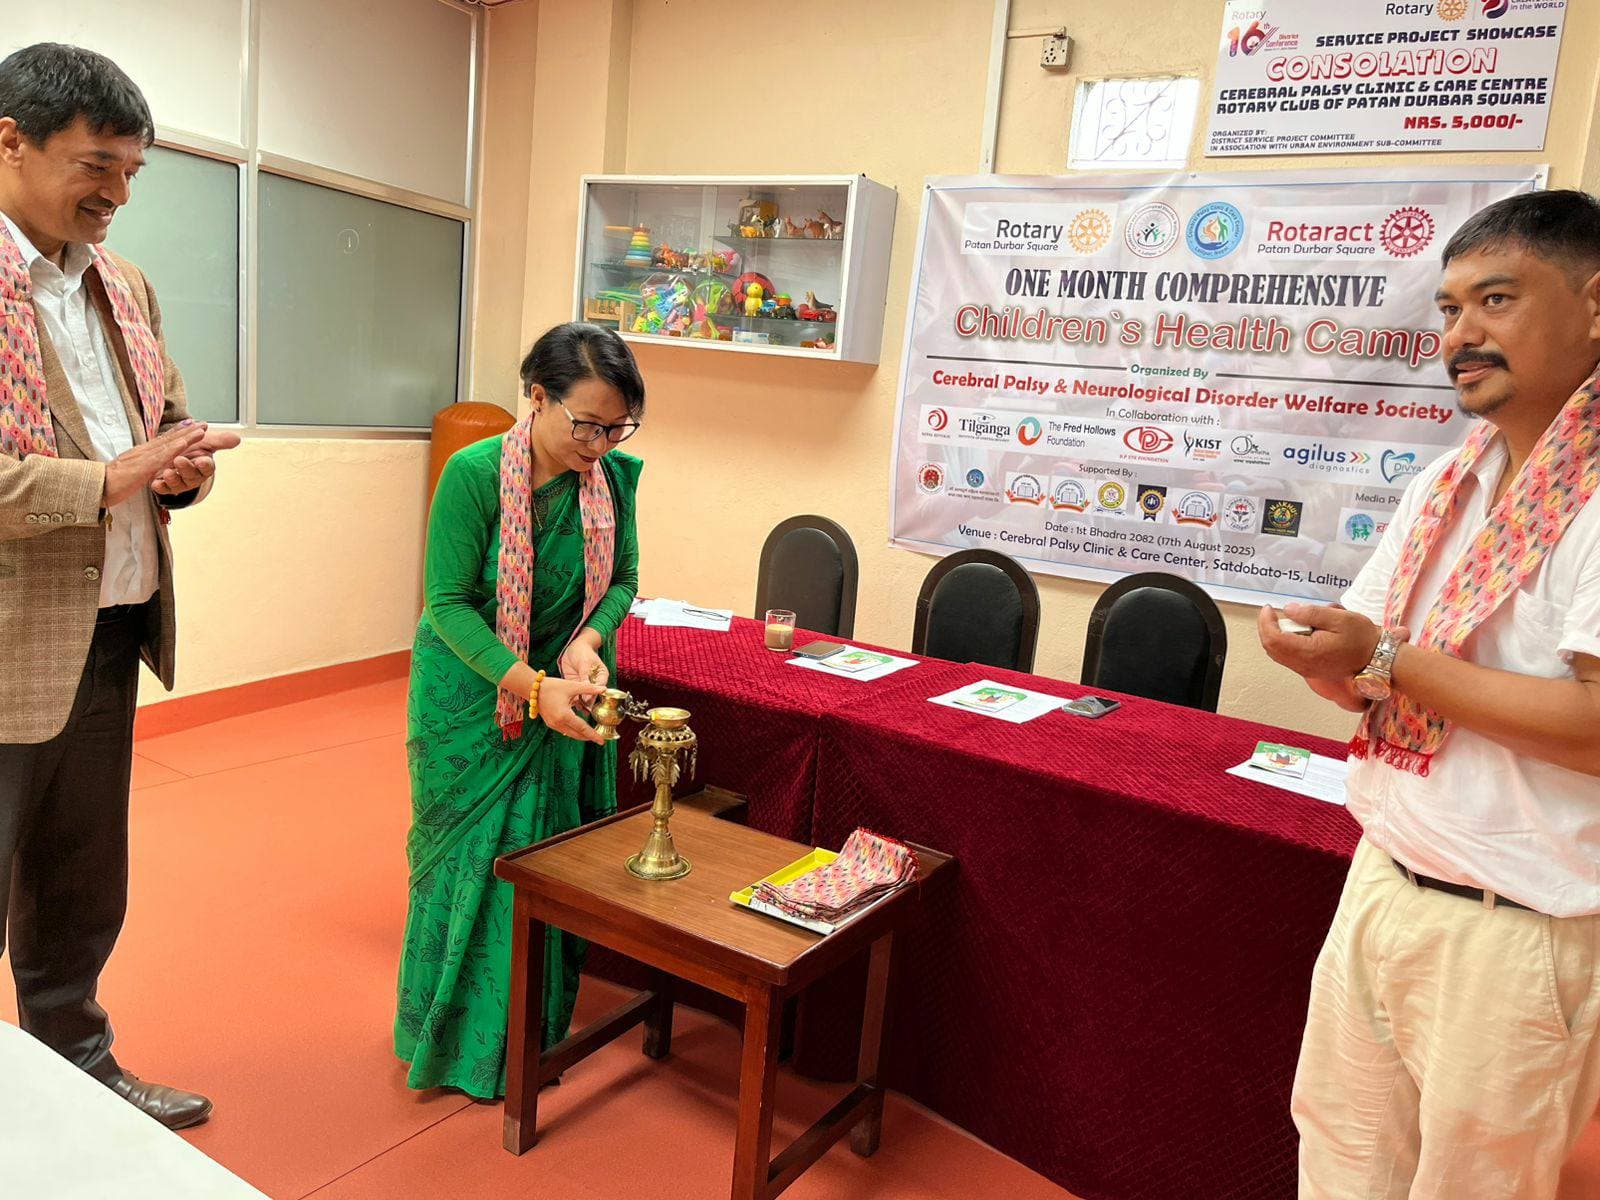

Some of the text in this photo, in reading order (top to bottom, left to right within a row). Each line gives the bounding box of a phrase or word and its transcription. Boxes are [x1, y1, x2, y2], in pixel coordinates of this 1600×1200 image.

[1232, 10, 1267, 21] Rotary
[1386, 3, 1434, 16] Rotary
[1316, 26, 1557, 47] SERVICE PROJECT SHOWCASE
[1266, 48, 1497, 82] CONSOLATION
[1220, 78, 1547, 101] CEREBRAL PALSY CLINIC & CARE CENTRE
[1217, 92, 1547, 114] ROTARY CLUB OF PATAN DURBAR SQUARE
[1404, 114, 1523, 130] NRS. 5,000/-
[1219, 143, 1267, 151] ASSOCIATION
[1318, 140, 1374, 148] ENVIRONMENT
[1376, 139, 1442, 147] SUB-COMMITTEE
[1310, 133, 1355, 141] COMMITTEE
[996, 219, 1063, 243] Rotary
[1267, 221, 1374, 242] Rotaract
[965, 239, 1058, 252] Patan Durbar Square
[1257, 243, 1290, 254] Patan
[1293, 244, 1333, 255] Durbar
[1336, 244, 1375, 256] Square
[1005, 268, 1387, 307] ONE MONTH COMPREHENSIVE
[1153, 313, 1291, 354] Health
[1304, 318, 1442, 368] Camp
[1131, 364, 1209, 379] Organized By
[932, 370, 1454, 424] Cerebral Palsy & Neurological Disorder Welfare Society
[1106, 408, 1115, 418] In
[1118, 408, 1188, 424] Collaboration
[1191, 415, 1214, 426] with
[959, 418, 1011, 438] Tilganga
[1049, 421, 1116, 436] The Fred Hollows
[1047, 435, 1085, 448] Foundation
[1195, 438, 1222, 450] KIST
[1283, 444, 1346, 465] agilus
[1079, 464, 1120, 477] Supported
[1121, 467, 1133, 479] By
[1309, 462, 1370, 474] diagnostics
[1355, 493, 1385, 504] Media
[1045, 521, 1069, 533] Date
[1076, 525, 1087, 536] 1st
[1090, 527, 1127, 541] Bhadra
[1129, 532, 1155, 544] 2082
[1157, 535, 1181, 548] (17th
[1184, 538, 1221, 553] August
[1224, 544, 1255, 558] 2025)
[958, 524, 991, 540] Venue
[1000, 529, 1046, 548] Cerebral
[1050, 537, 1080, 553] Palsy
[1083, 541, 1115, 557] Clinic
[1117, 546, 1128, 558] &
[1131, 549, 1160, 563] Care
[1164, 552, 1208, 570] Center,
[1213, 557, 1304, 584] Satdobato-15,
